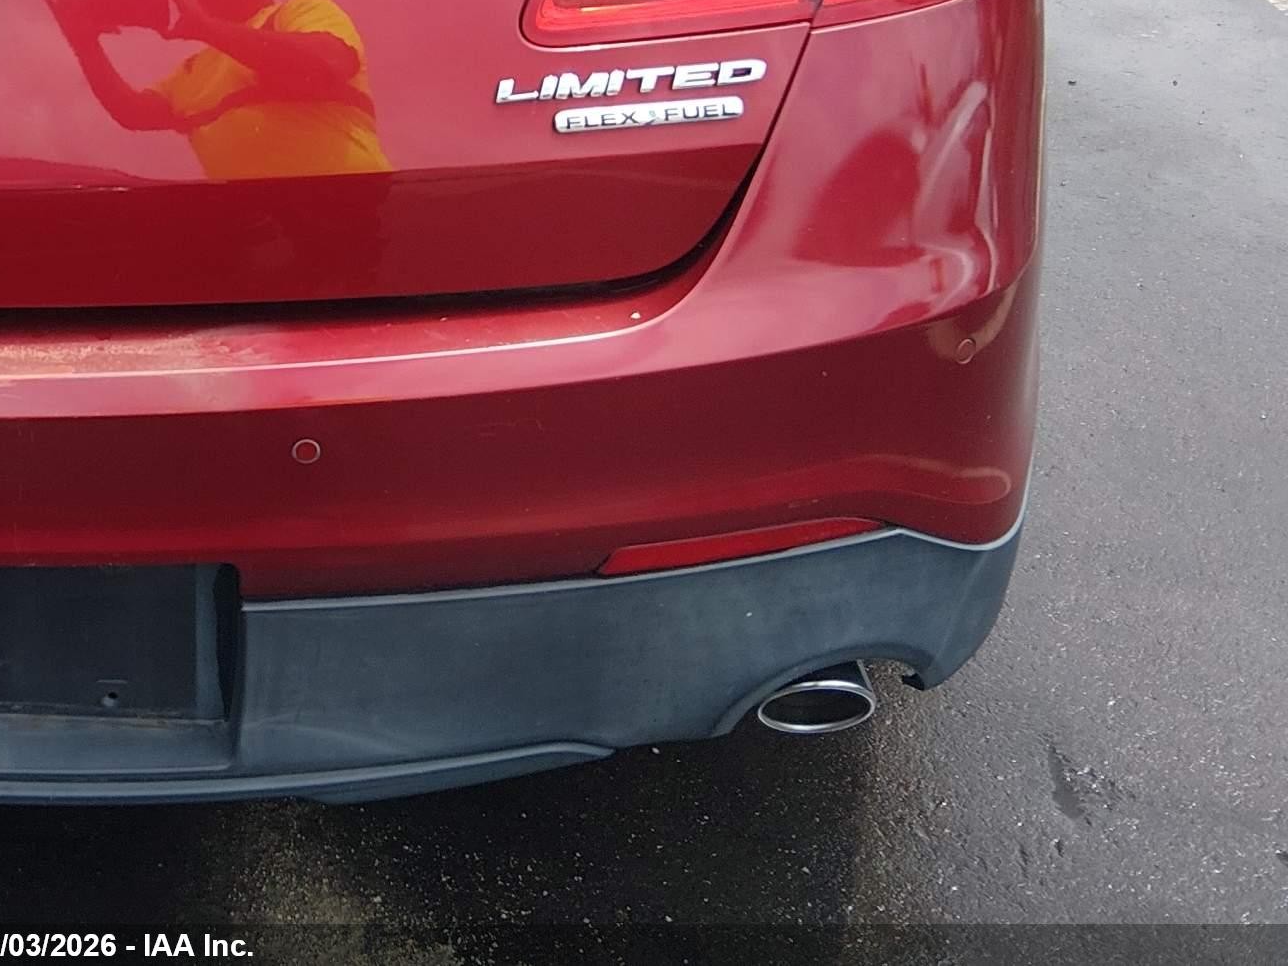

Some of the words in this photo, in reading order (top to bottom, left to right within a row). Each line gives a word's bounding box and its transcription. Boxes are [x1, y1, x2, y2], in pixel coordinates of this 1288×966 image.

[495, 59, 768, 104] LIMITED
[566, 111, 640, 130] FLEX
[664, 103, 737, 122] FUEL
